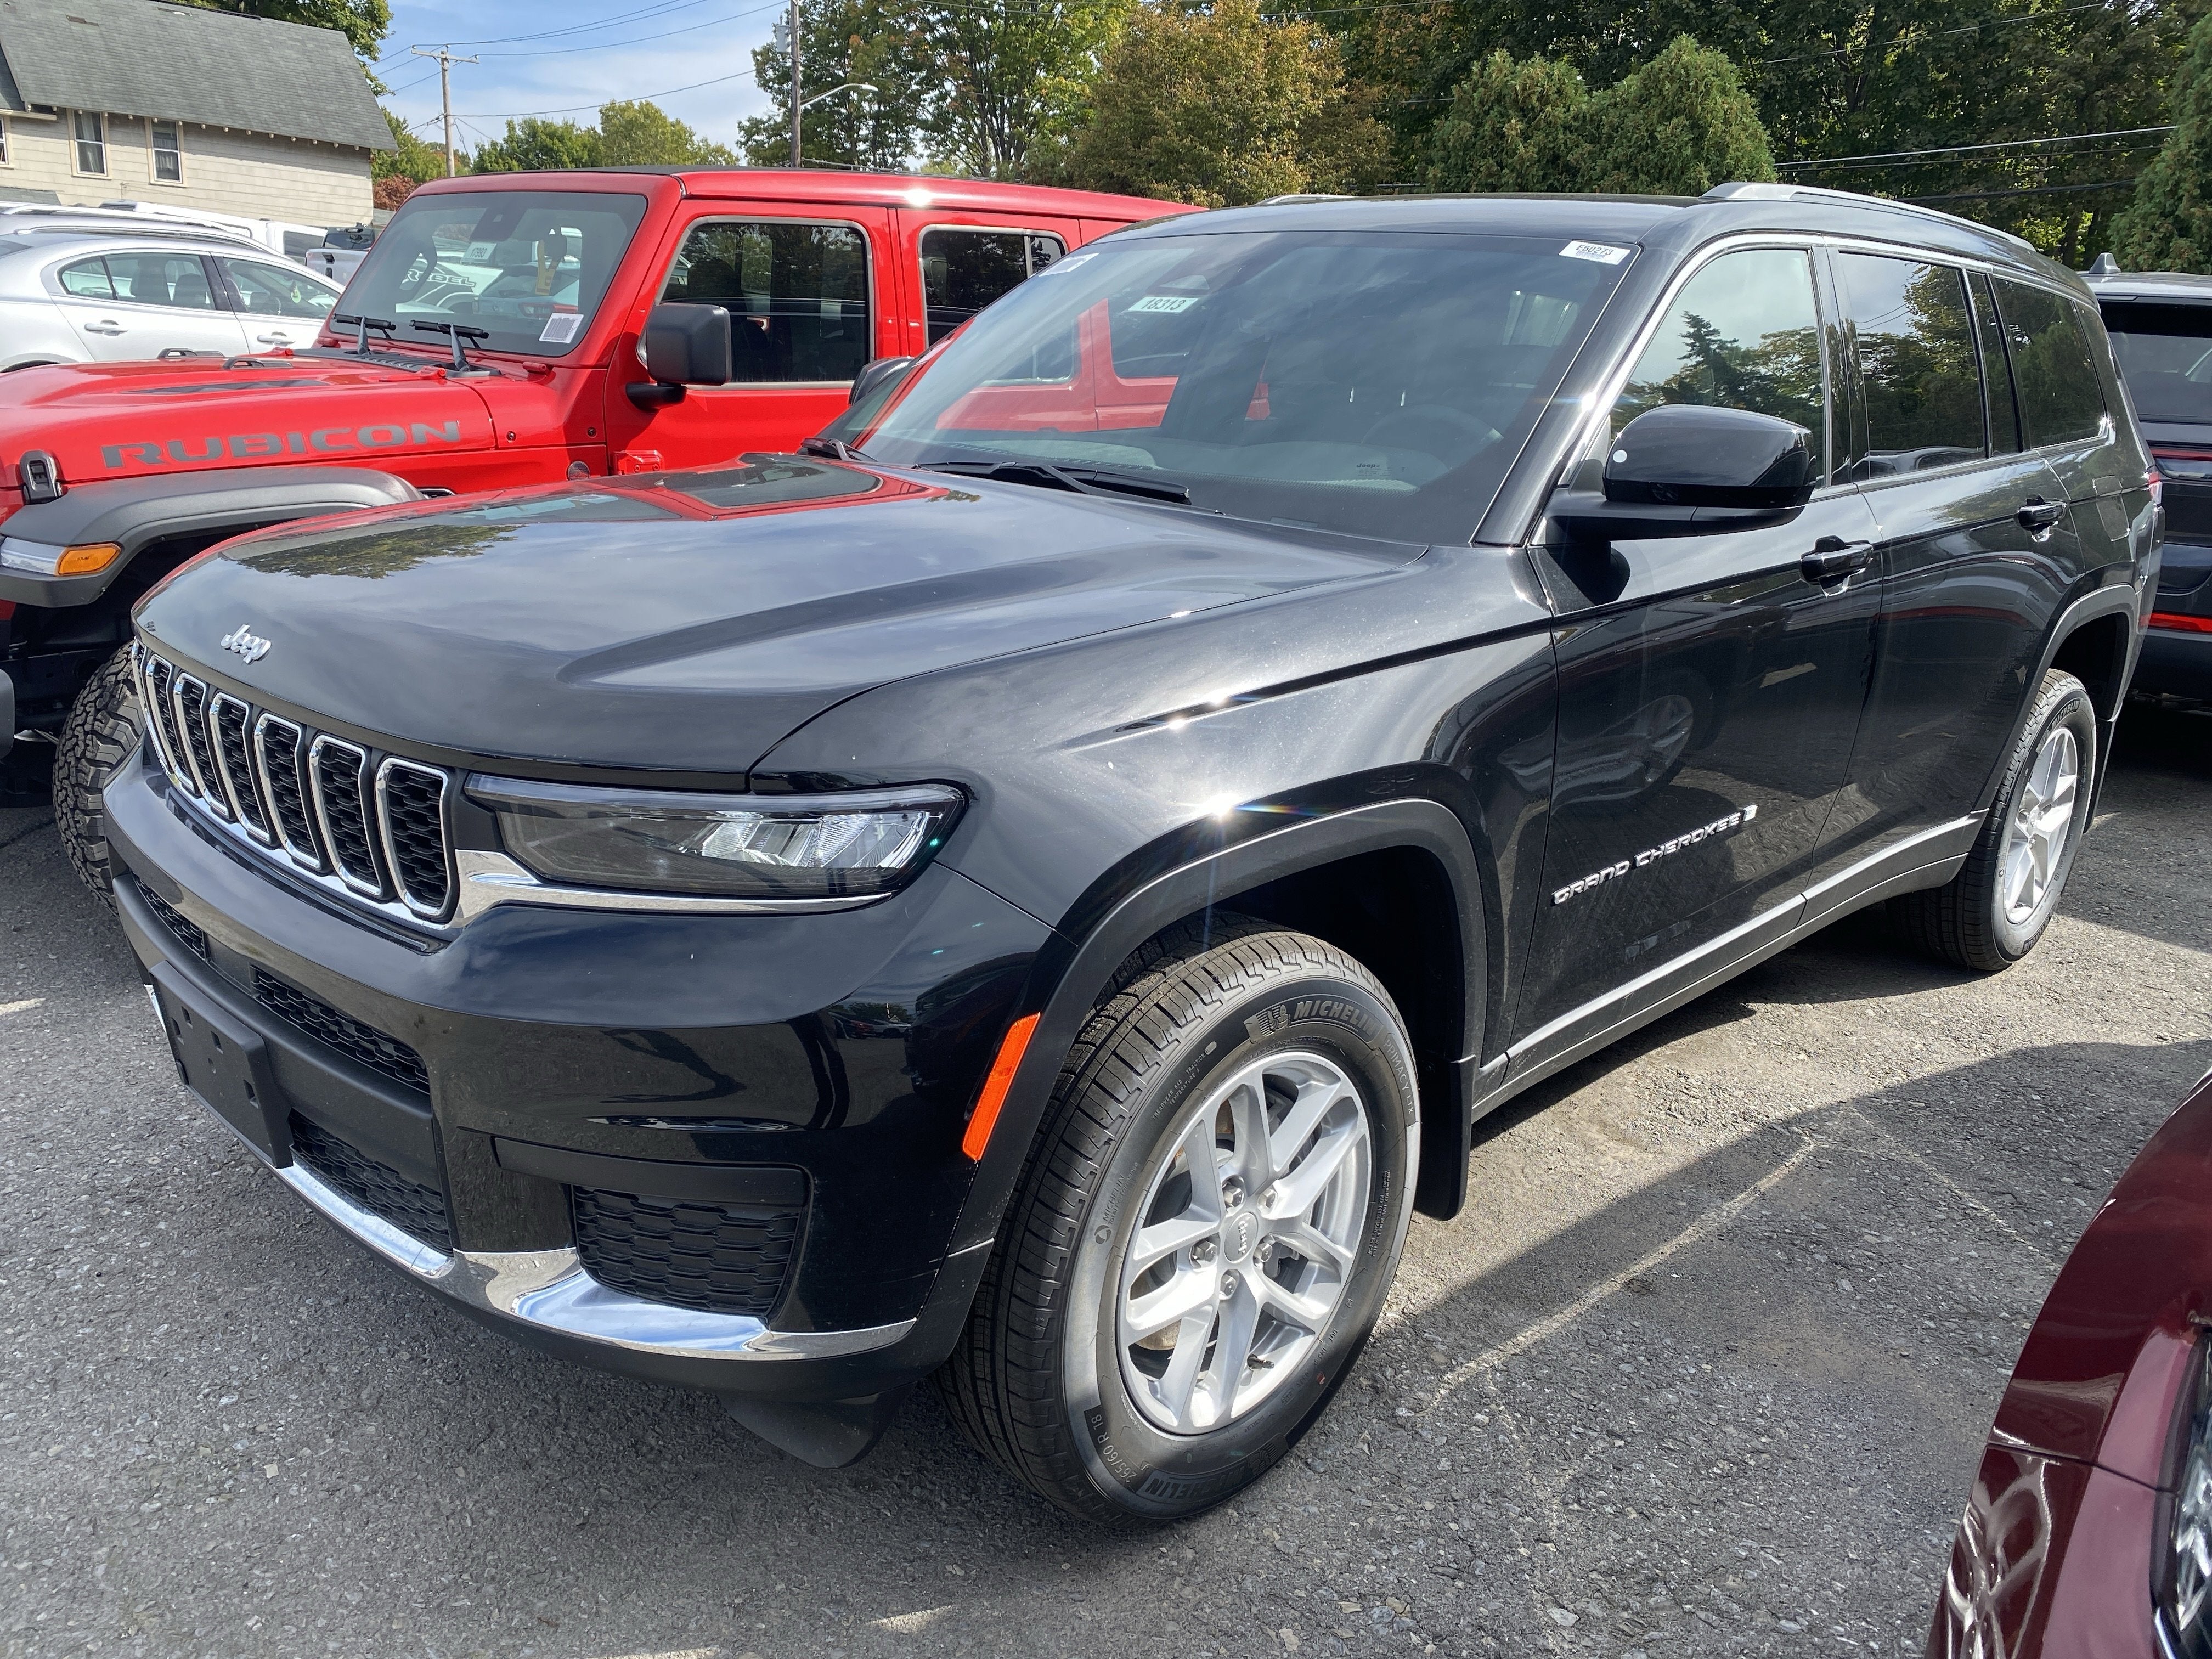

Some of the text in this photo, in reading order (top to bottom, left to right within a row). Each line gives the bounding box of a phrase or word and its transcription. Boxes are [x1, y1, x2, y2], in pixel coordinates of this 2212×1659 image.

[1576, 244, 1614, 256] E50273
[1143, 298, 1187, 311] 18313
[101, 420, 460, 469] RUBICON
[221, 624, 272, 664] Jeep
[1551, 811, 1742, 905] GRAND CHEROKEE
[1294, 1000, 1379, 1037] MICHELIN
[1383, 1039, 1410, 1091] PRIMACY
[1103, 1173, 1125, 1222] MICHELIN
[1091, 1414, 1104, 1430] 18
[1097, 1431, 1110, 1444] R
[1103, 1444, 1137, 1482] 265/60
